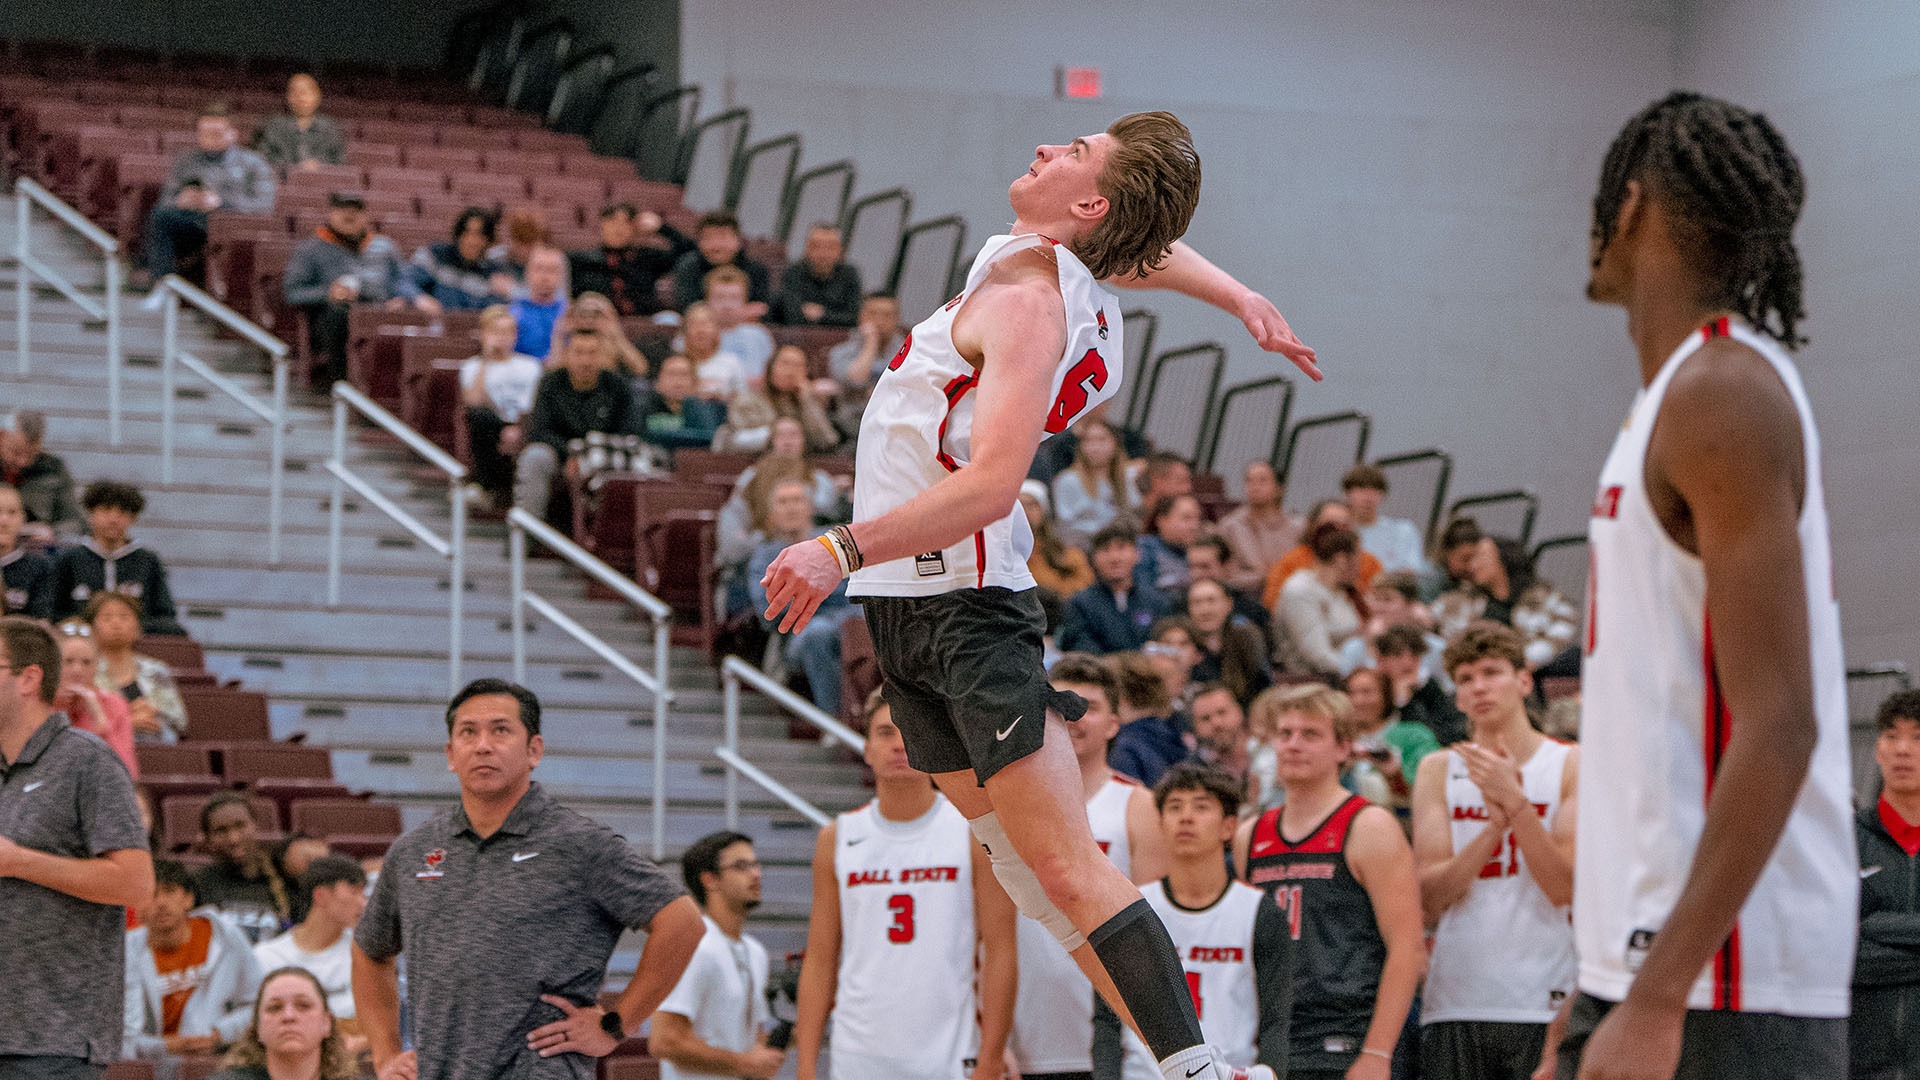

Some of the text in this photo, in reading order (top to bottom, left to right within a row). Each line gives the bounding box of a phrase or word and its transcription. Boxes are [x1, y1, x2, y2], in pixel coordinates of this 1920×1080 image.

[1045, 348, 1108, 434] 6
[847, 867, 959, 888] BALL STATE
[887, 893, 916, 945] 3
